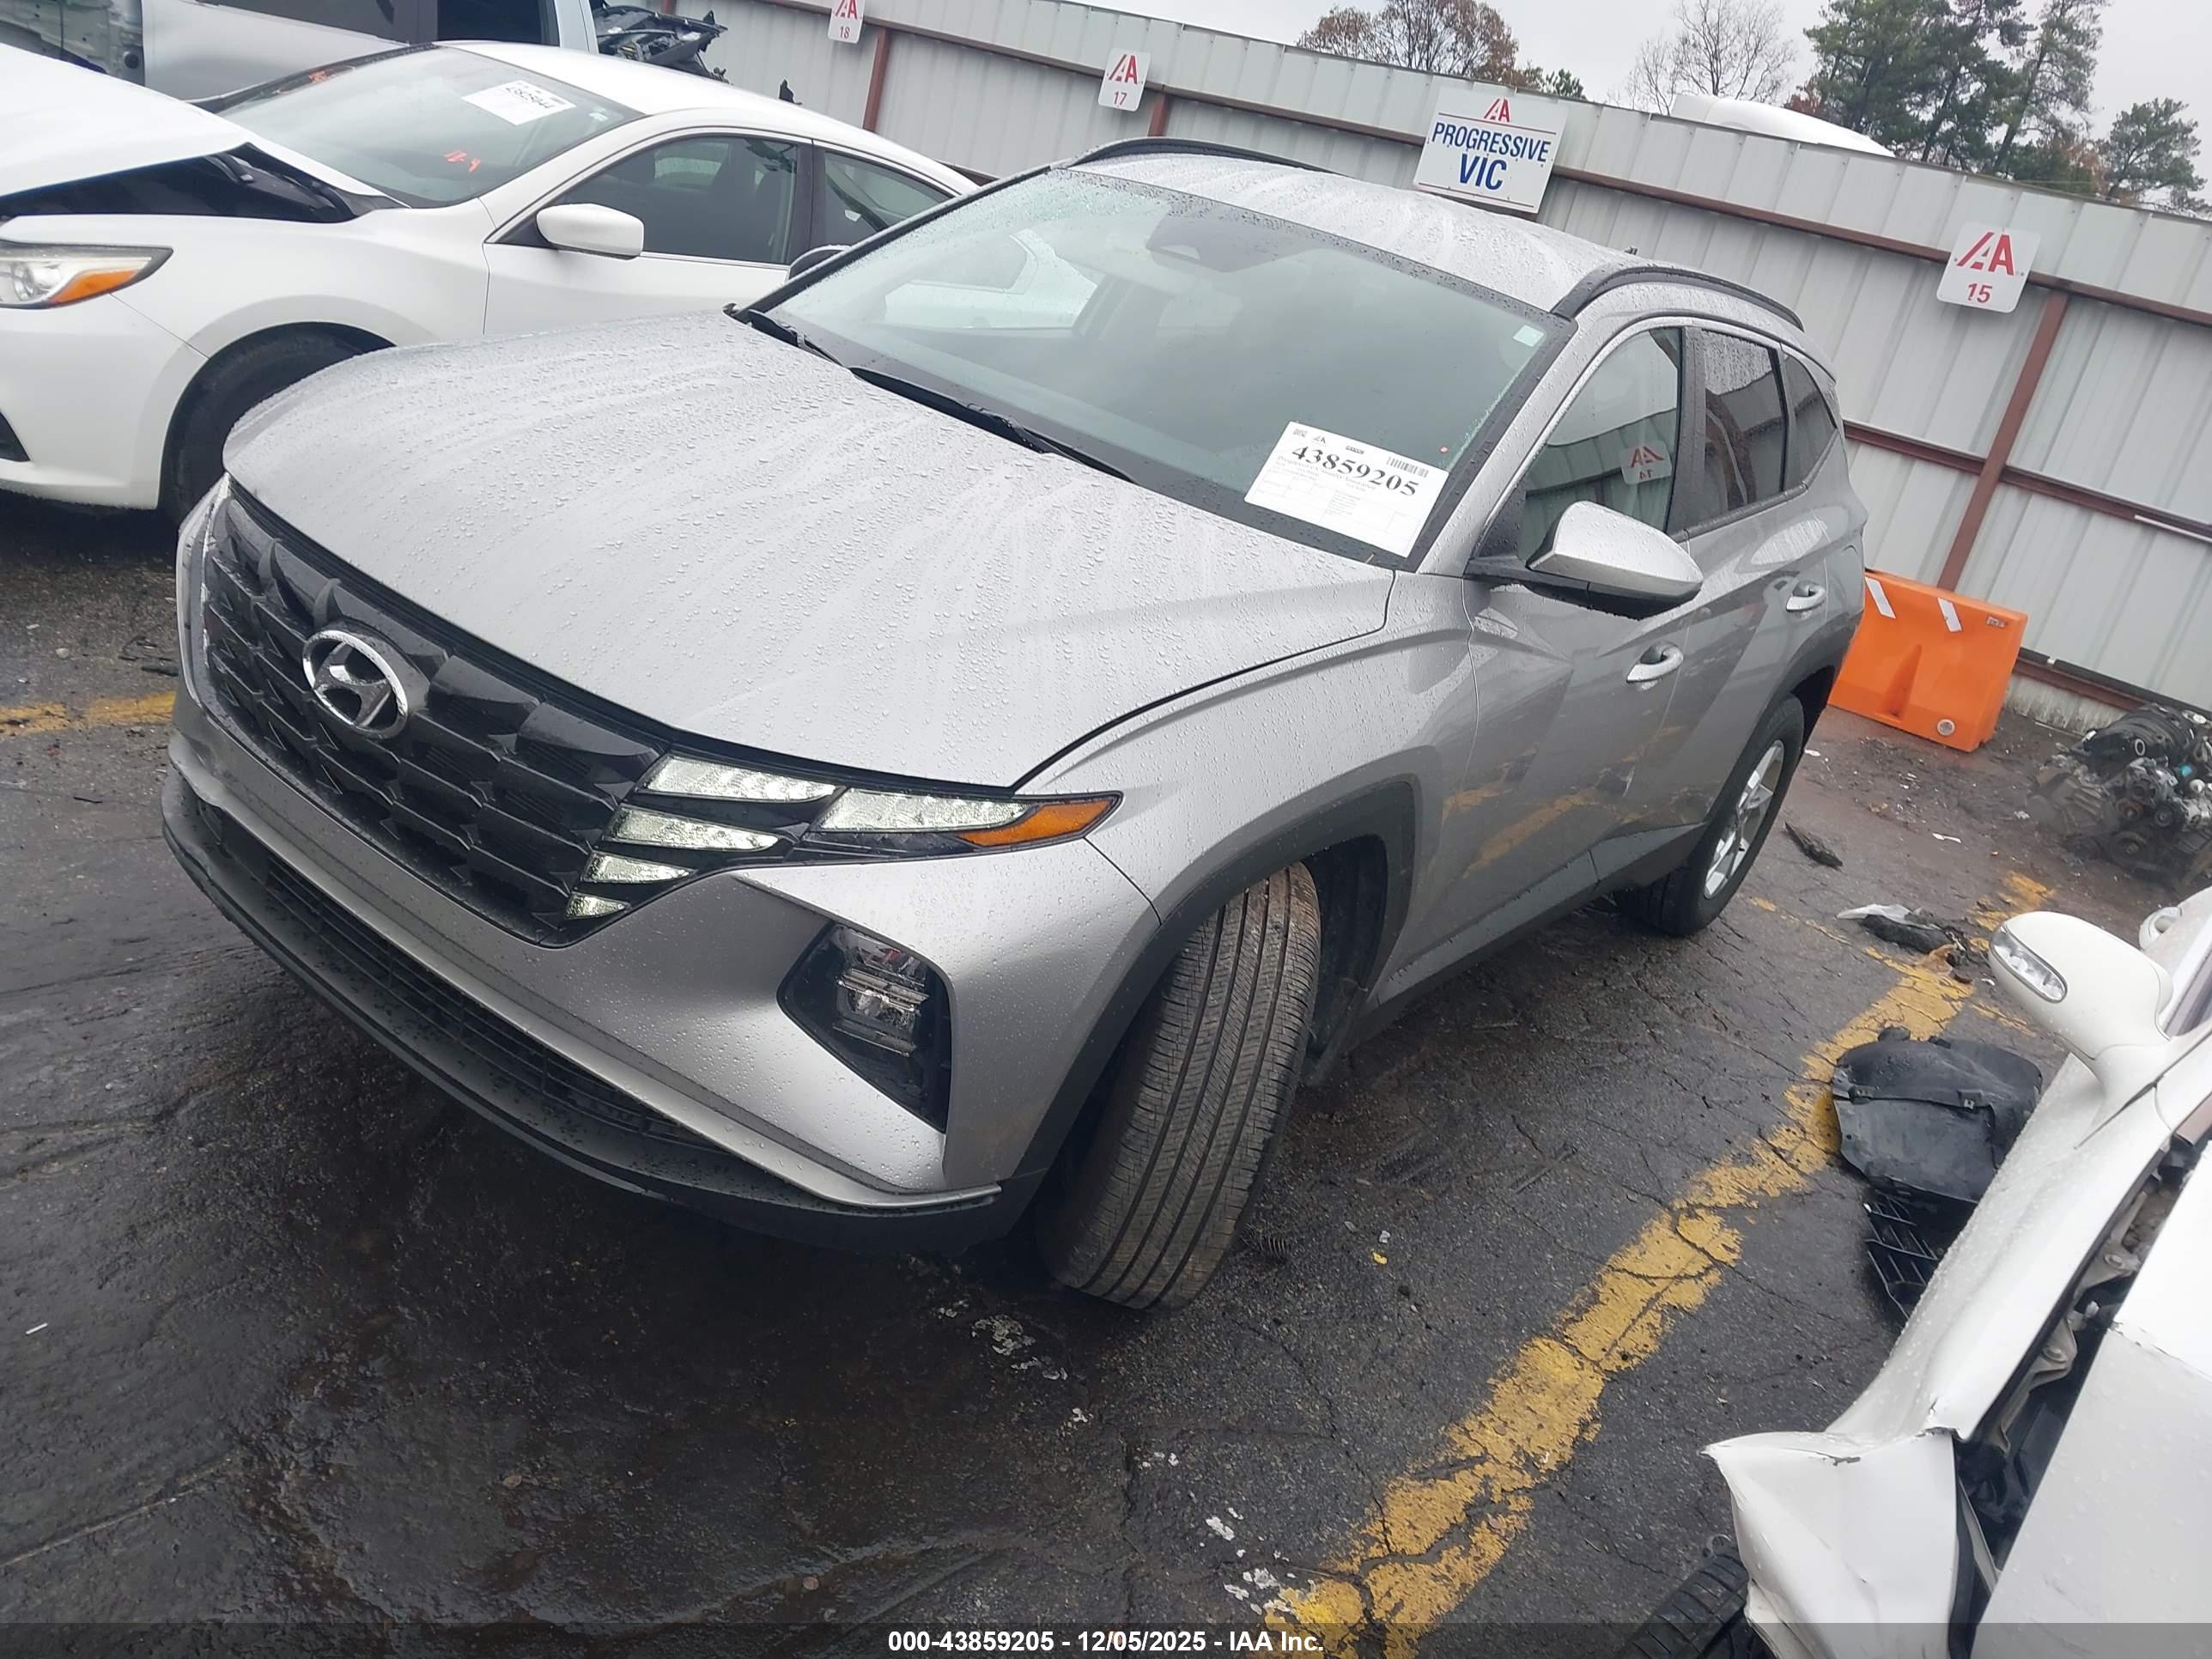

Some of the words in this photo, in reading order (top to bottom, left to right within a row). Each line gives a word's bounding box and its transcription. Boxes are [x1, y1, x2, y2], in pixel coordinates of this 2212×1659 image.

[839, 26, 850, 39] 18
[1114, 91, 1127, 106] 17
[1431, 122, 1551, 162] PROGRESSIVE
[1460, 153, 1507, 191] VIC
[1967, 283, 1992, 303] 15
[1291, 446, 1419, 496] 43859205
